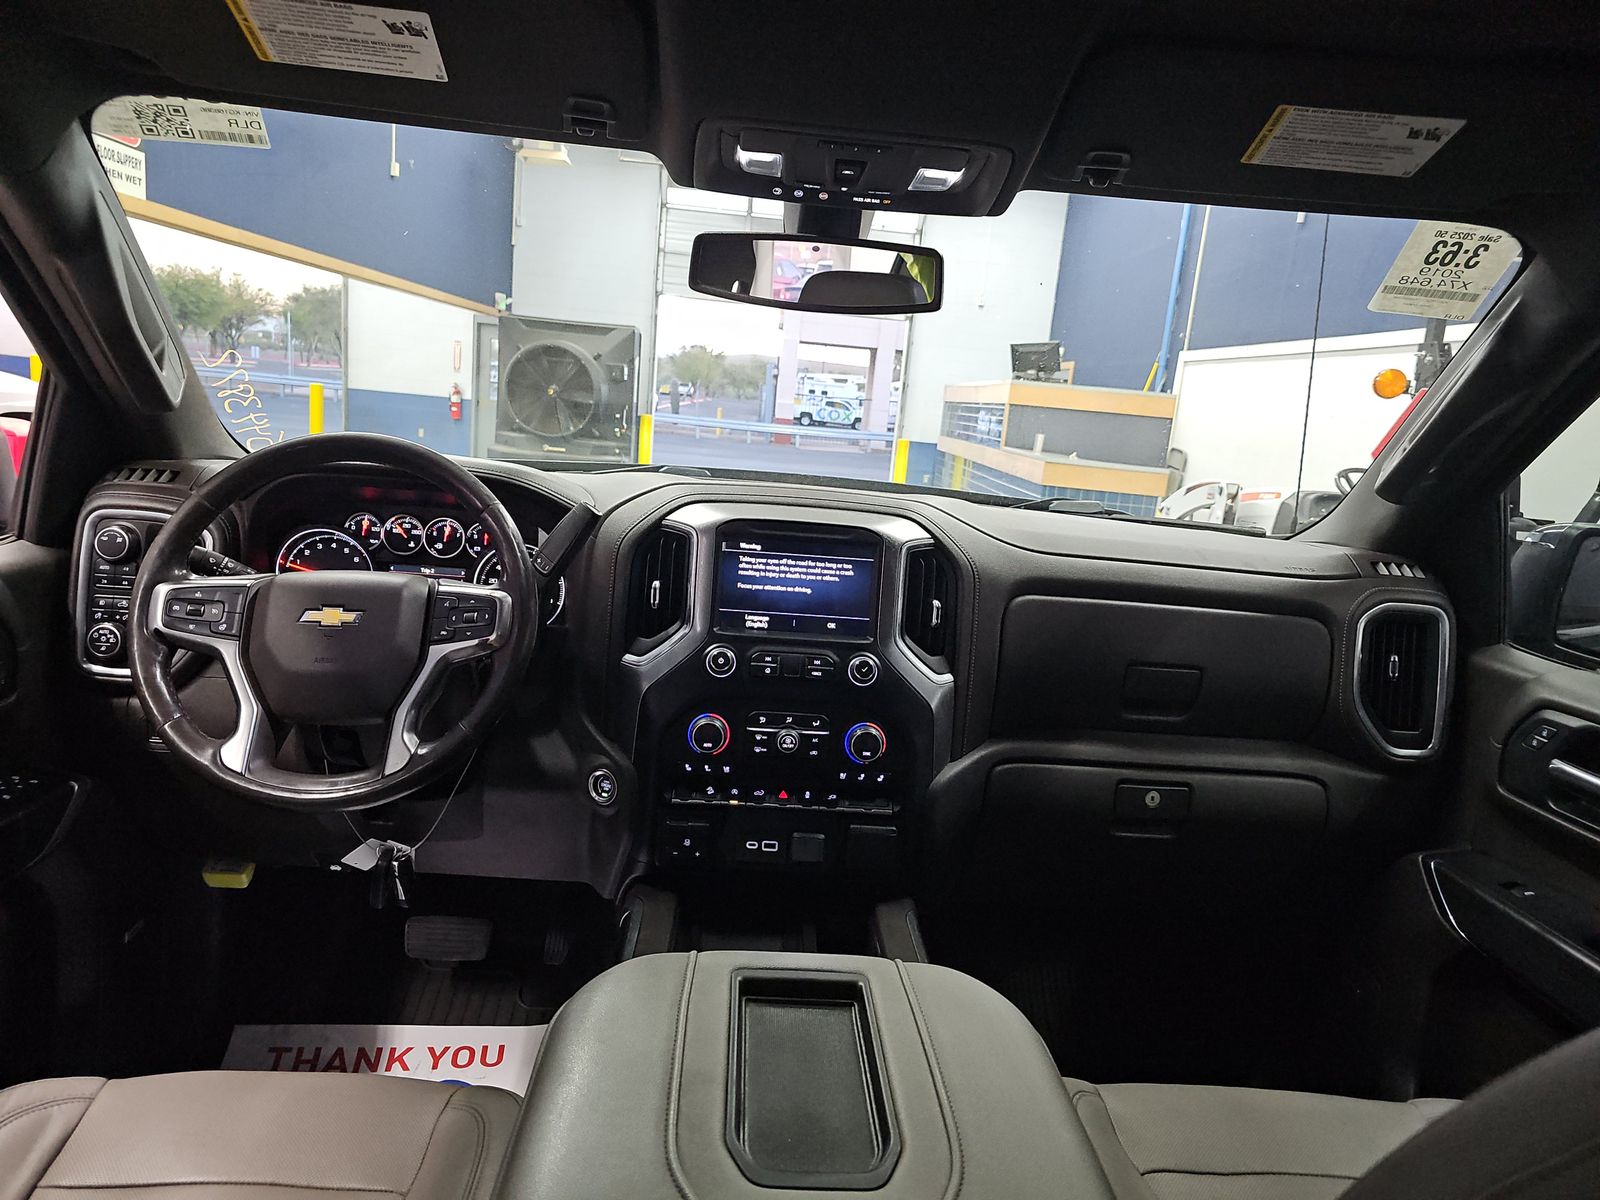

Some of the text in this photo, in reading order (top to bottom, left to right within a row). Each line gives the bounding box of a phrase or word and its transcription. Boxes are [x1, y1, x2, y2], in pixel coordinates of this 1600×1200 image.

[117, 151, 142, 171] SLIPPERY
[106, 167, 142, 187] HEN WET
[817, 407, 853, 422] COX
[740, 542, 761, 551] Warning
[745, 614, 770, 622] Language
[267, 1044, 505, 1073] THANK YOU
